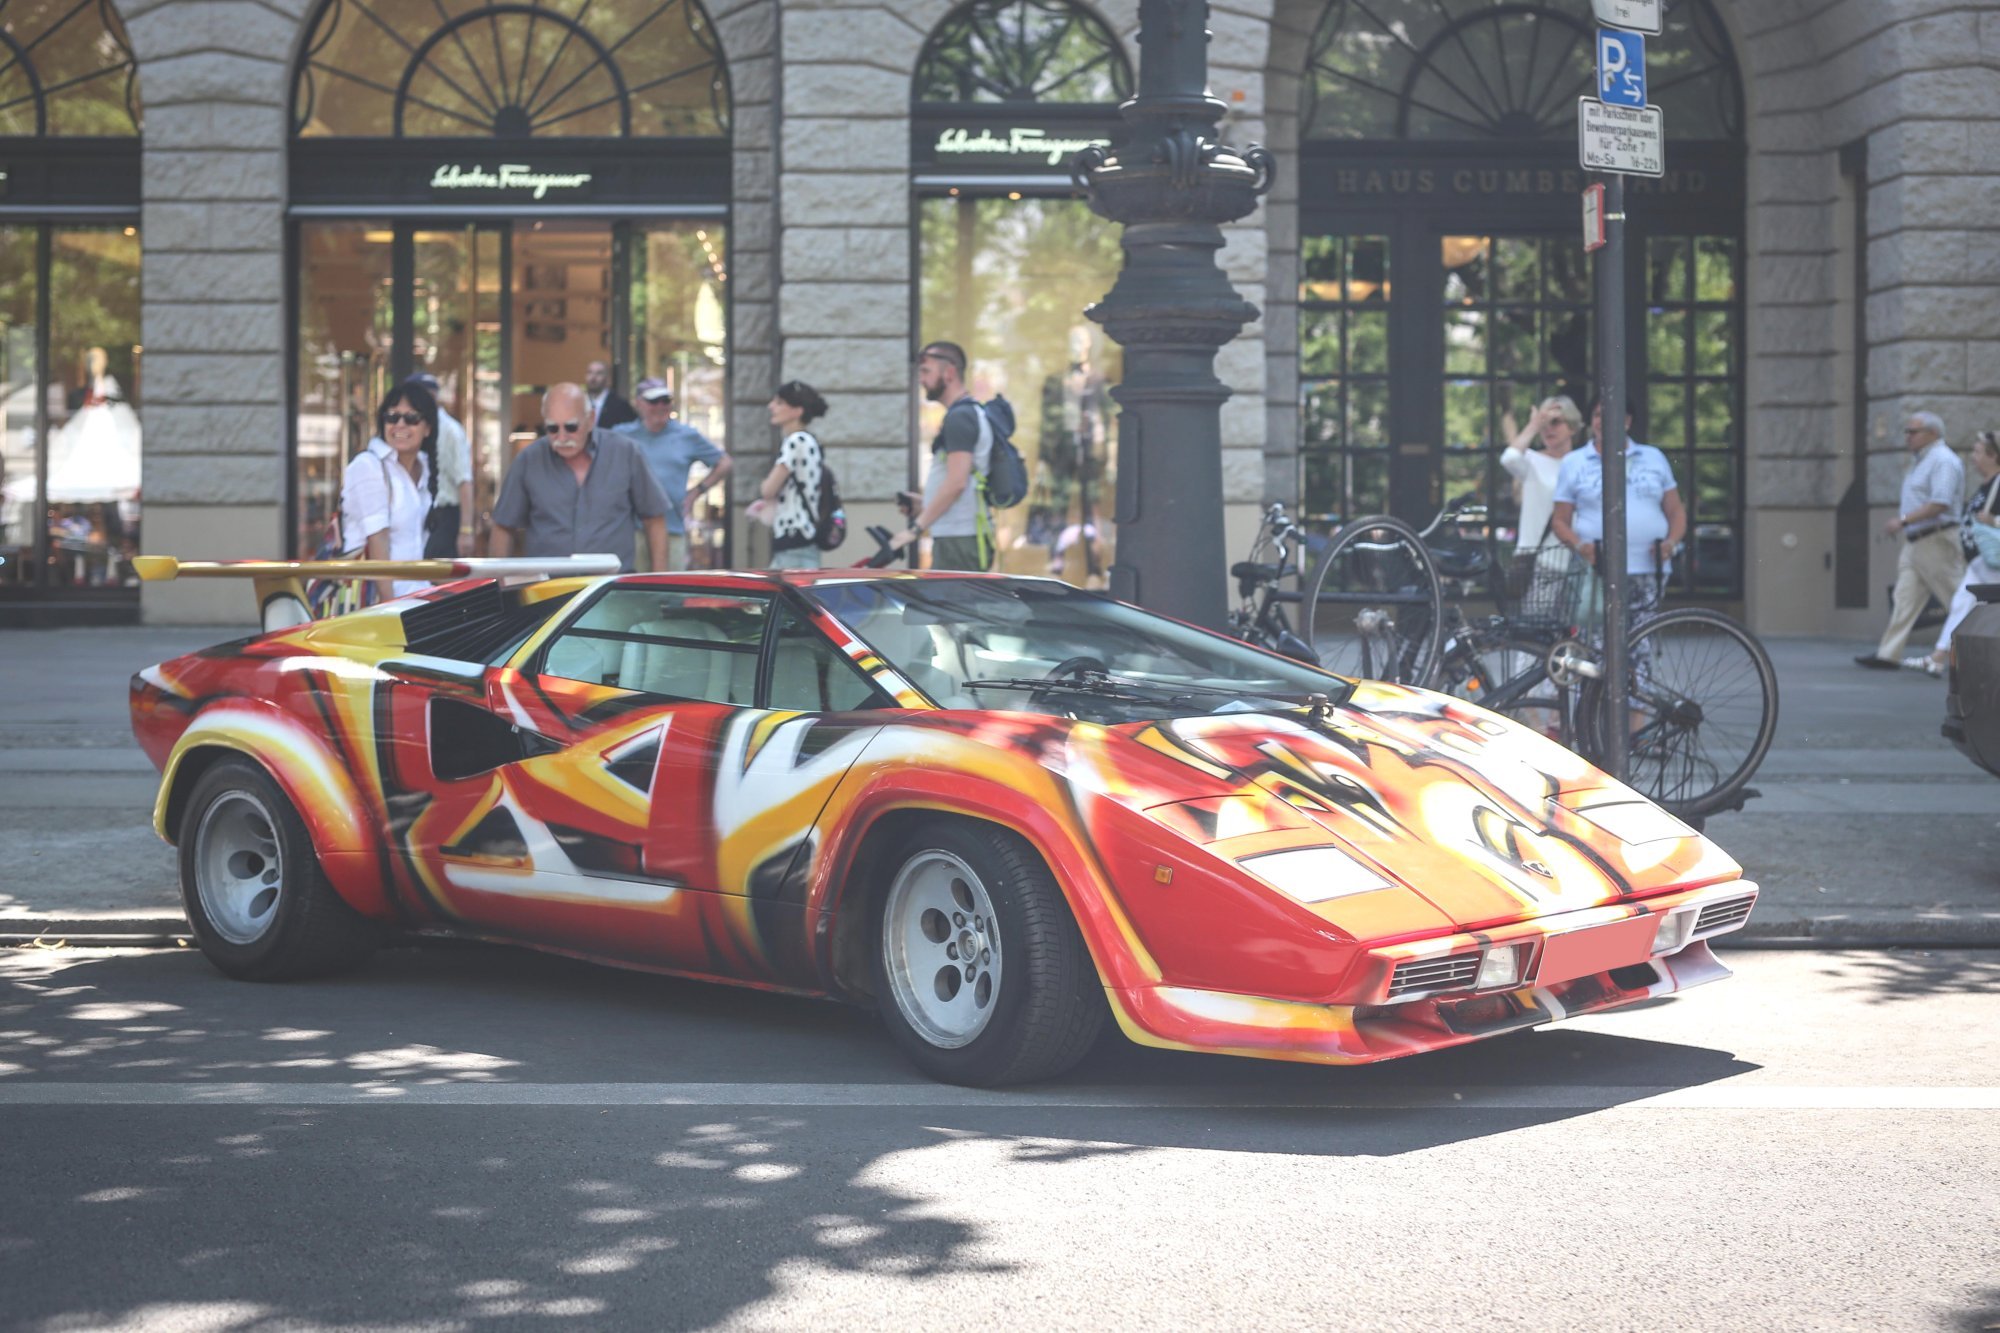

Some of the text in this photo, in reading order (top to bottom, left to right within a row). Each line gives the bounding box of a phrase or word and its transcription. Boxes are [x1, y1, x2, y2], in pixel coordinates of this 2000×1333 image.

[1602, 37, 1627, 92] P
[1603, 107, 1637, 121] Parkschein
[1586, 120, 1657, 139] Bewohnerparkausweis
[1599, 137, 1612, 150] für
[1337, 169, 1435, 193] HAUS
